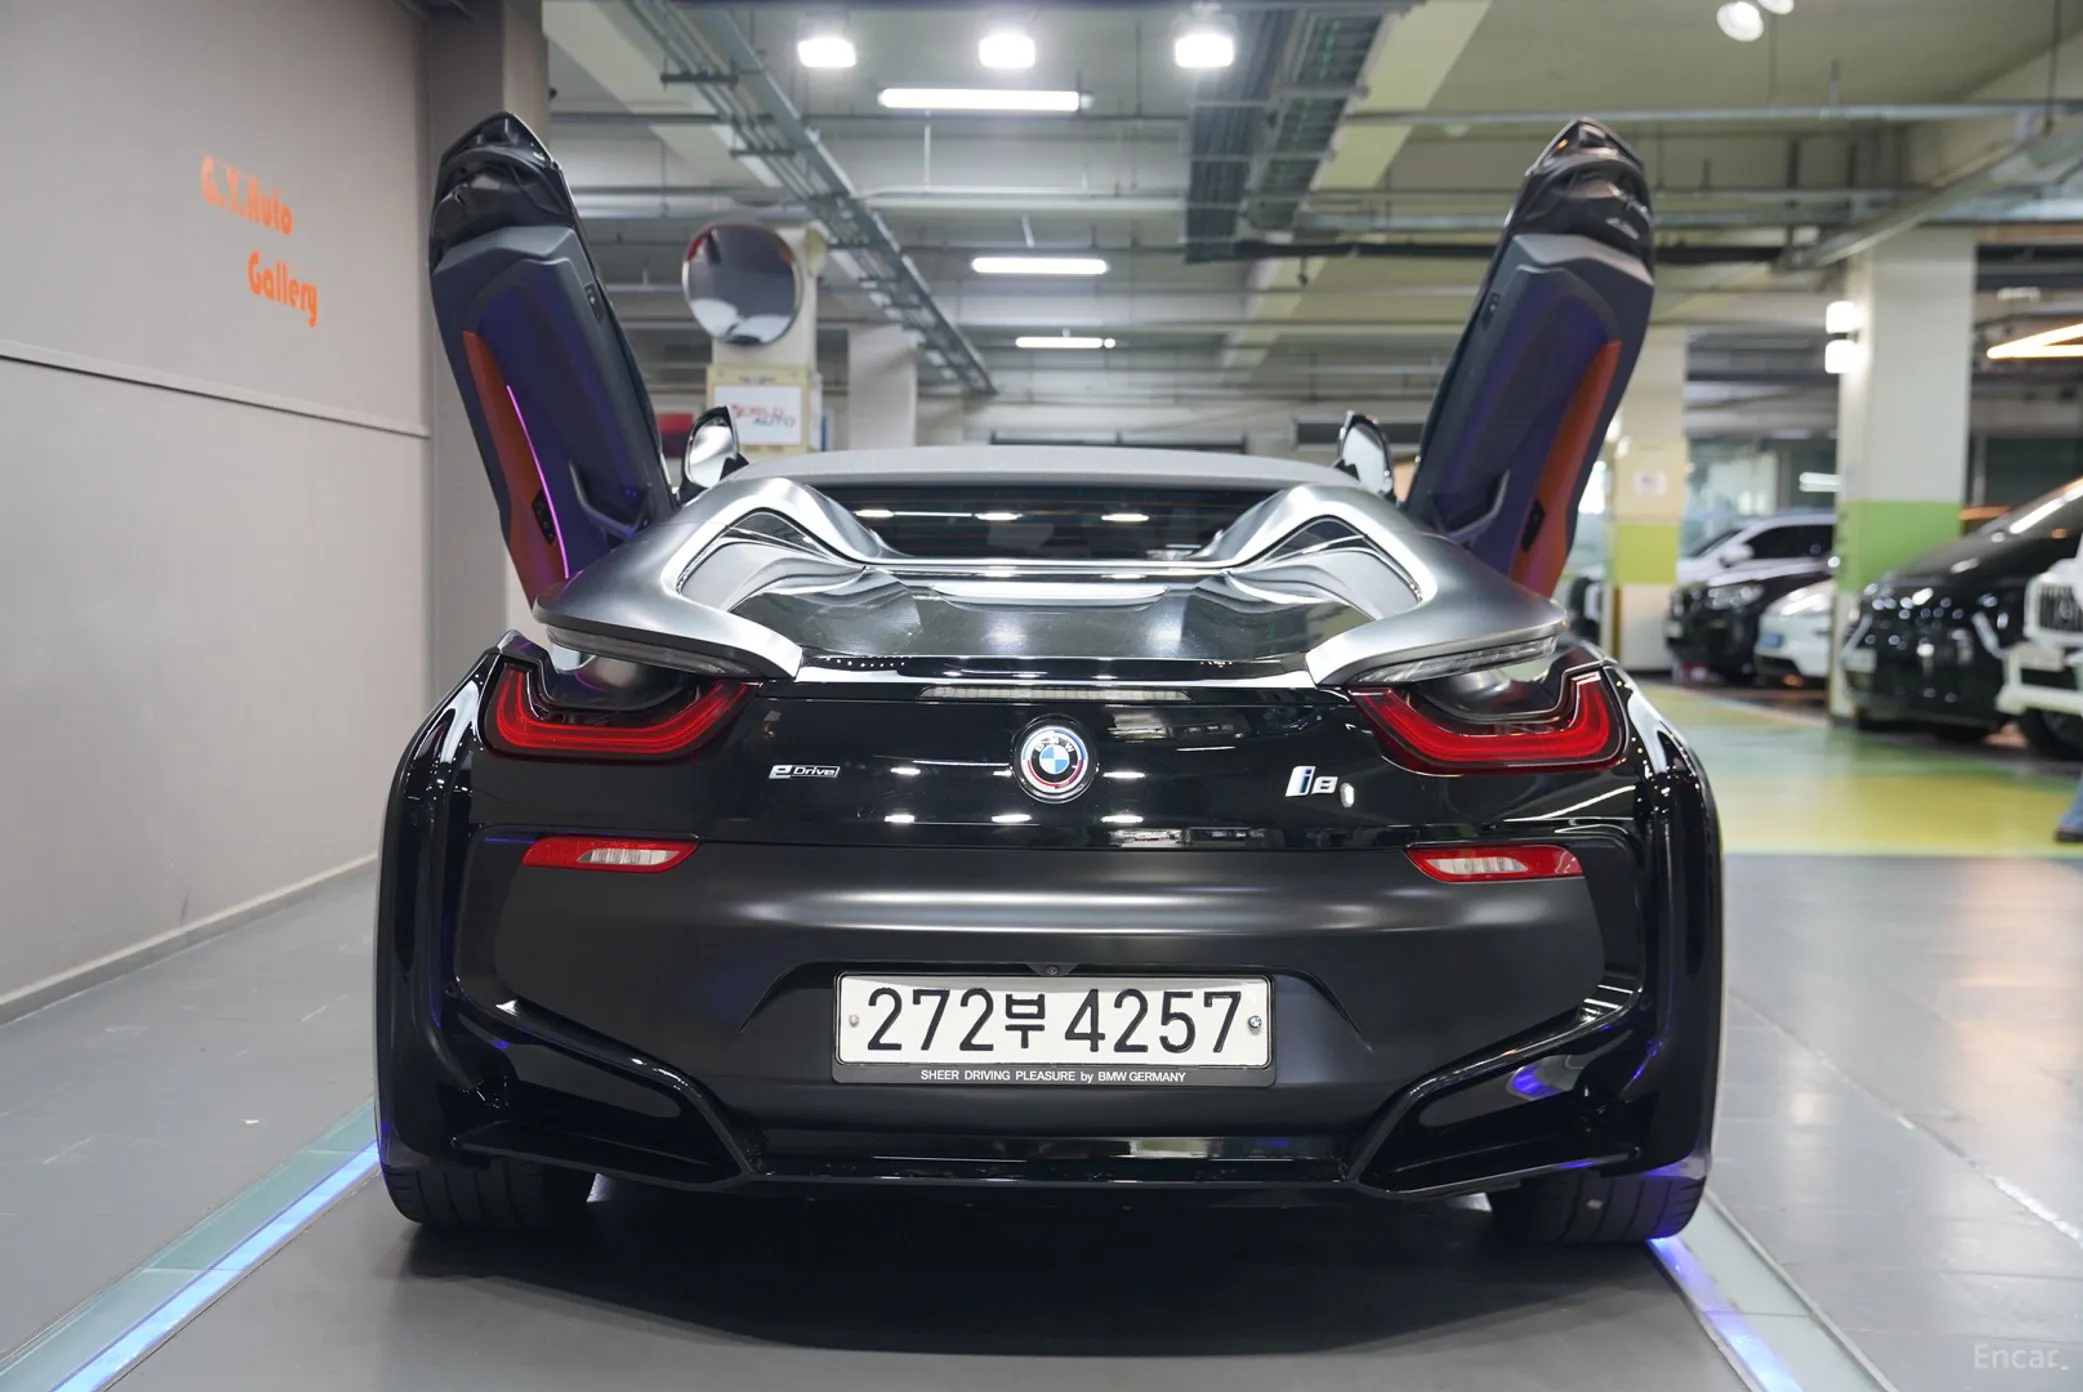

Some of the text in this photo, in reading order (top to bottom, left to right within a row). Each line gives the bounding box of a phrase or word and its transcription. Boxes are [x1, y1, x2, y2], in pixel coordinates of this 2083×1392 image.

[248, 250, 318, 328] Gallery
[1285, 765, 1338, 797] i8
[1064, 988, 1241, 1053] 4257
[920, 1069, 1187, 1084] SHEER DRIVING PLEASURE by BMW GERMANY
